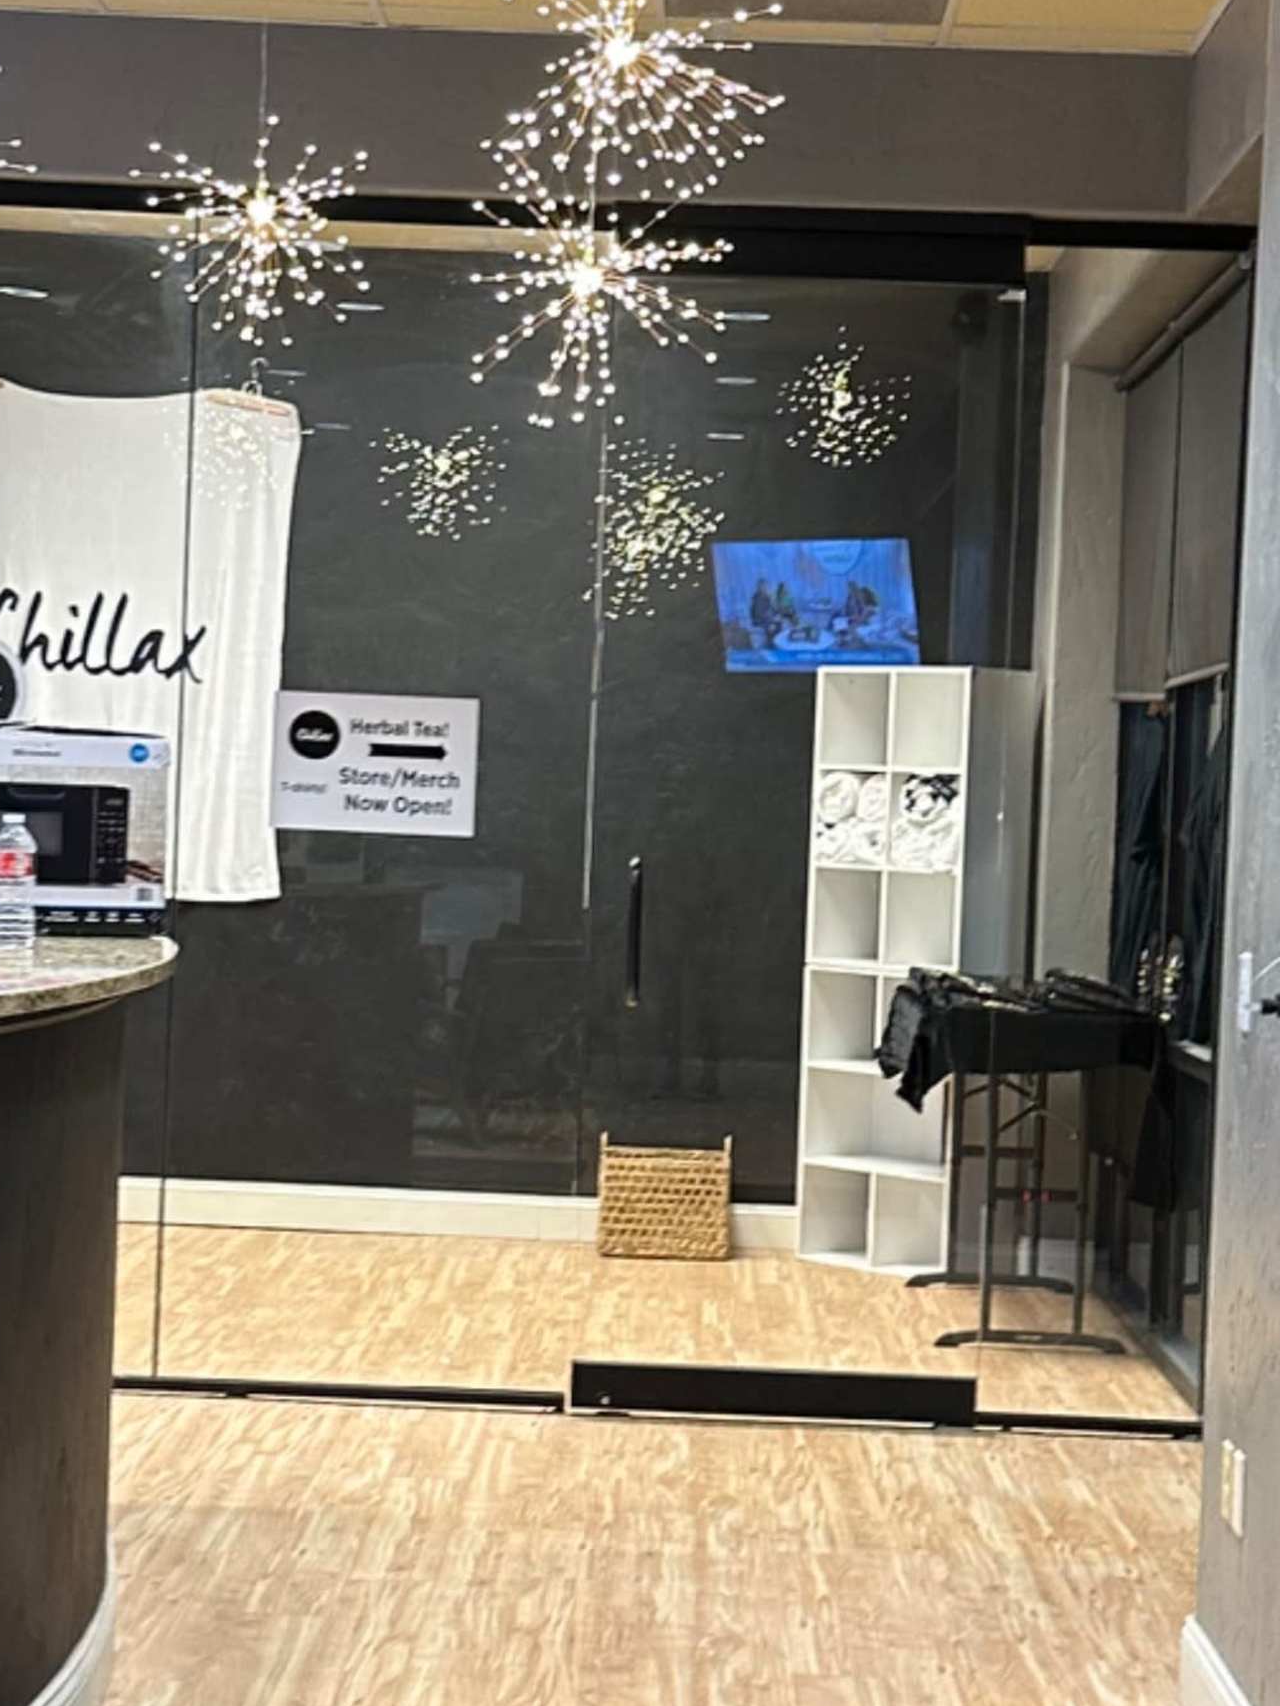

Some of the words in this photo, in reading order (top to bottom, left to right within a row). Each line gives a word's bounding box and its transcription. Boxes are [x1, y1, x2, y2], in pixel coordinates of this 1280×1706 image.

[350, 718, 409, 736] Herbal
[412, 720, 451, 738] Tea!
[338, 766, 461, 790] Store/Merch
[343, 794, 390, 812] Now
[392, 795, 453, 817] Open!
